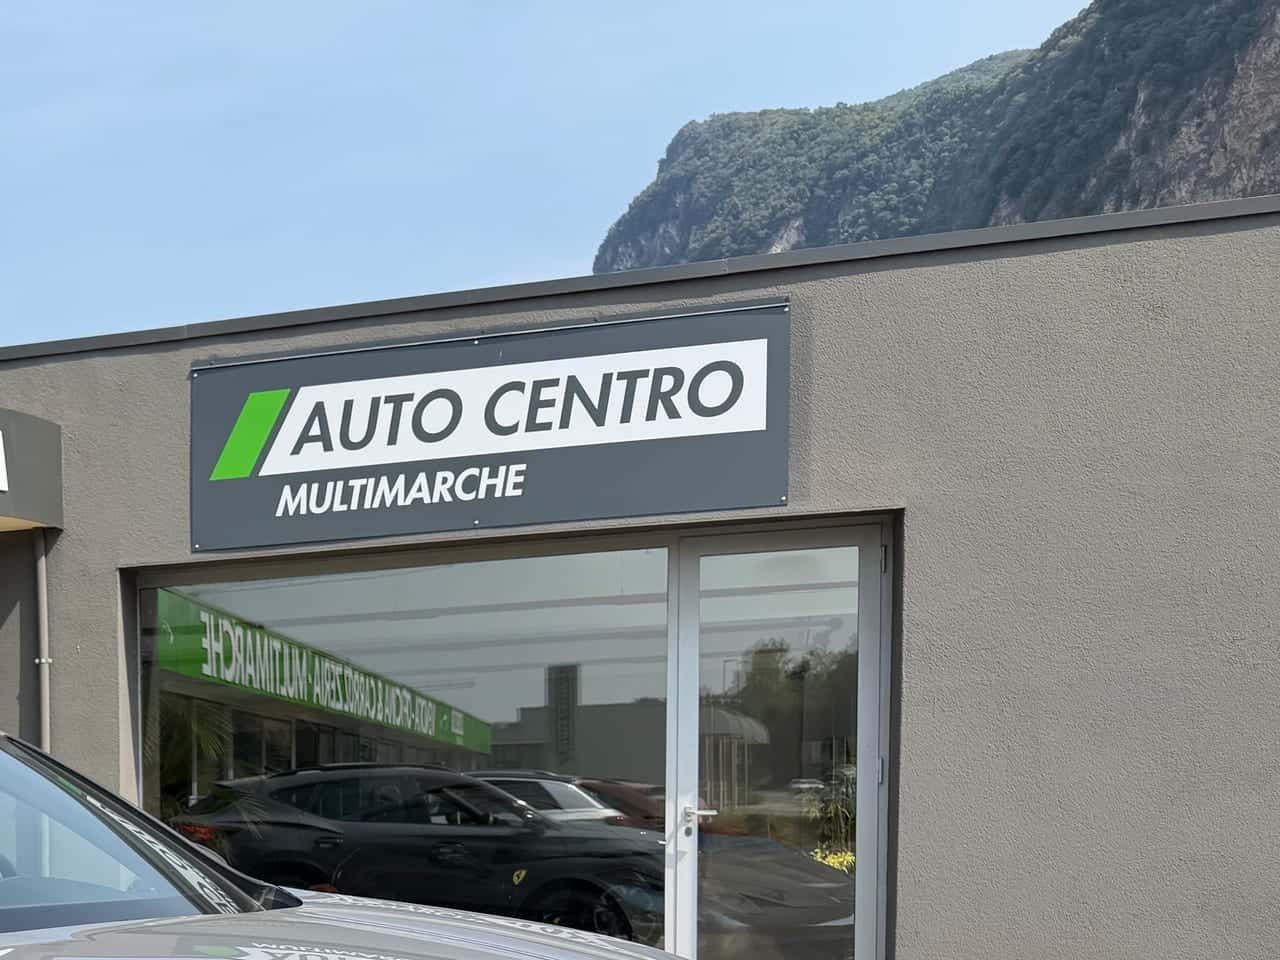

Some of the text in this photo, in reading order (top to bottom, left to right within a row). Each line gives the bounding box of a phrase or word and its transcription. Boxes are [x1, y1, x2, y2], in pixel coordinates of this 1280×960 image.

[290, 359, 746, 457] AUTO CENTRO
[274, 463, 528, 518] MULTIMARCHE
